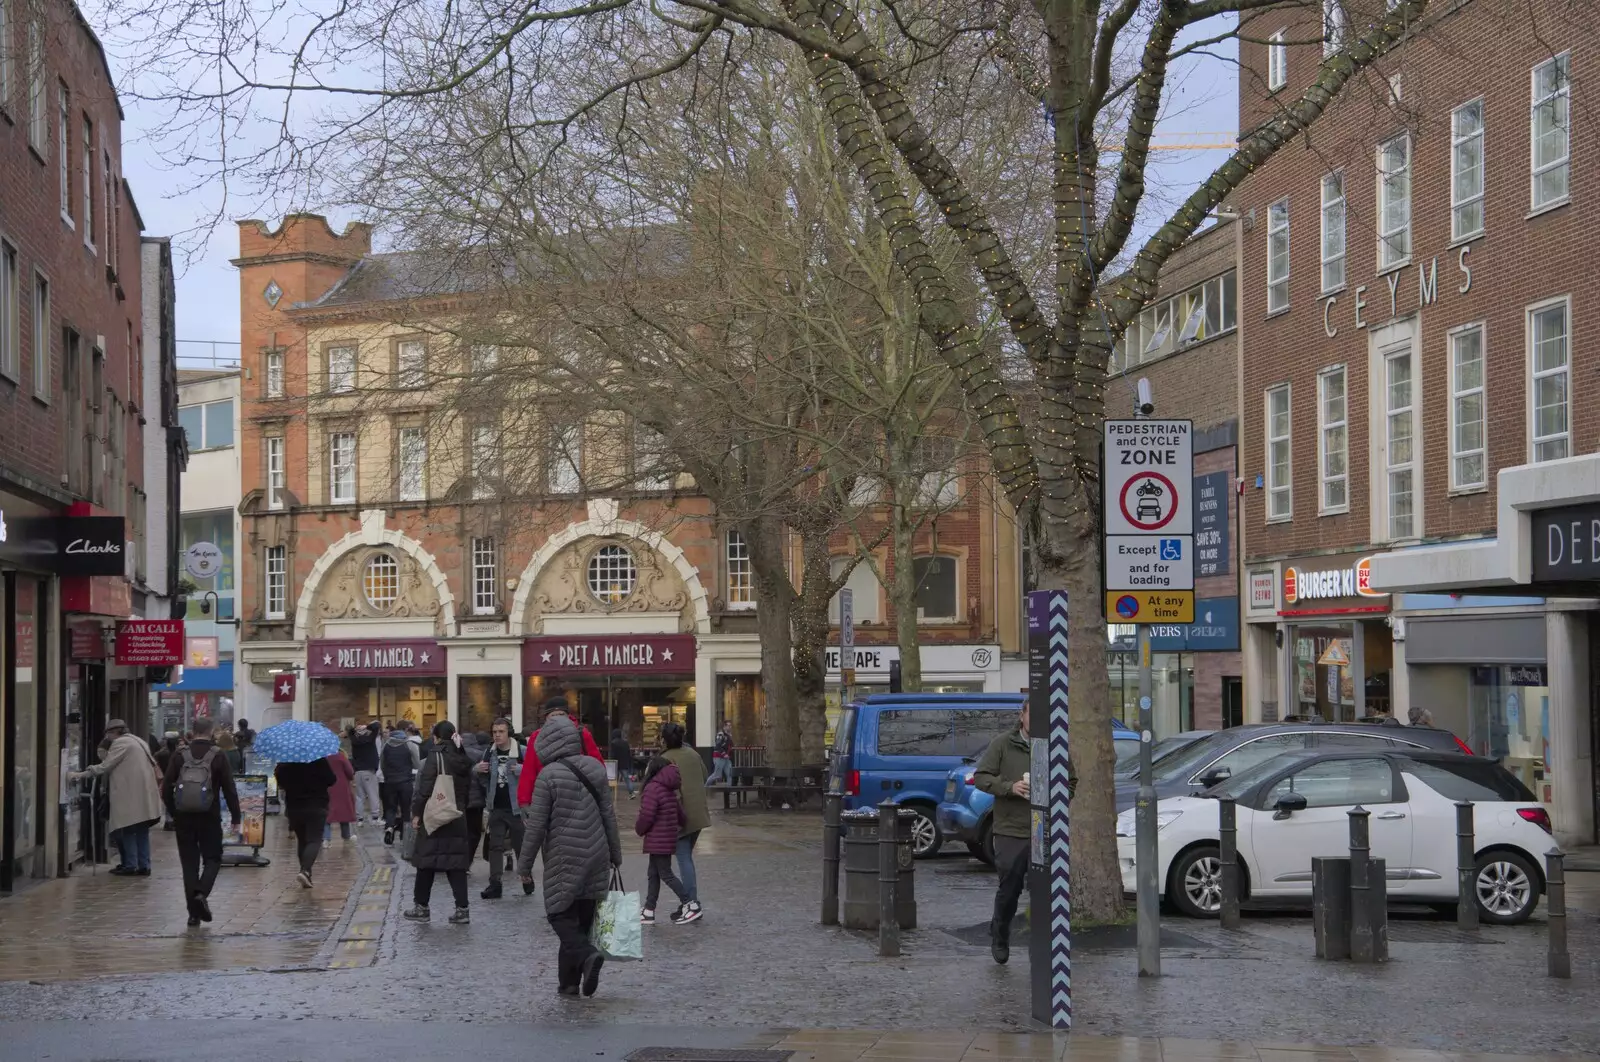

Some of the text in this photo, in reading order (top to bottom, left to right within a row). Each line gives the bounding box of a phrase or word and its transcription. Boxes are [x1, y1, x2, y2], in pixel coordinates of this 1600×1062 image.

[1324, 246, 1472, 338] CEYMS
[1109, 424, 1187, 434] PEDESTRIAN
[1116, 436, 1180, 446] and CYCLE
[1121, 450, 1176, 465] ZONE
[1196, 532, 1209, 546] SAVE
[1548, 519, 1600, 566] DEB
[65, 538, 121, 554] Clarks
[1118, 545, 1157, 556] Except
[1129, 563, 1170, 573] and for
[1129, 575, 1170, 586] loading
[1299, 569, 1355, 599] BURGER KI
[1148, 596, 1184, 607] At any
[1154, 608, 1179, 617] time
[120, 624, 179, 634] ZAM CALL
[337, 647, 414, 669] PRET A MANGER
[559, 644, 654, 666] PRET A MANGER
